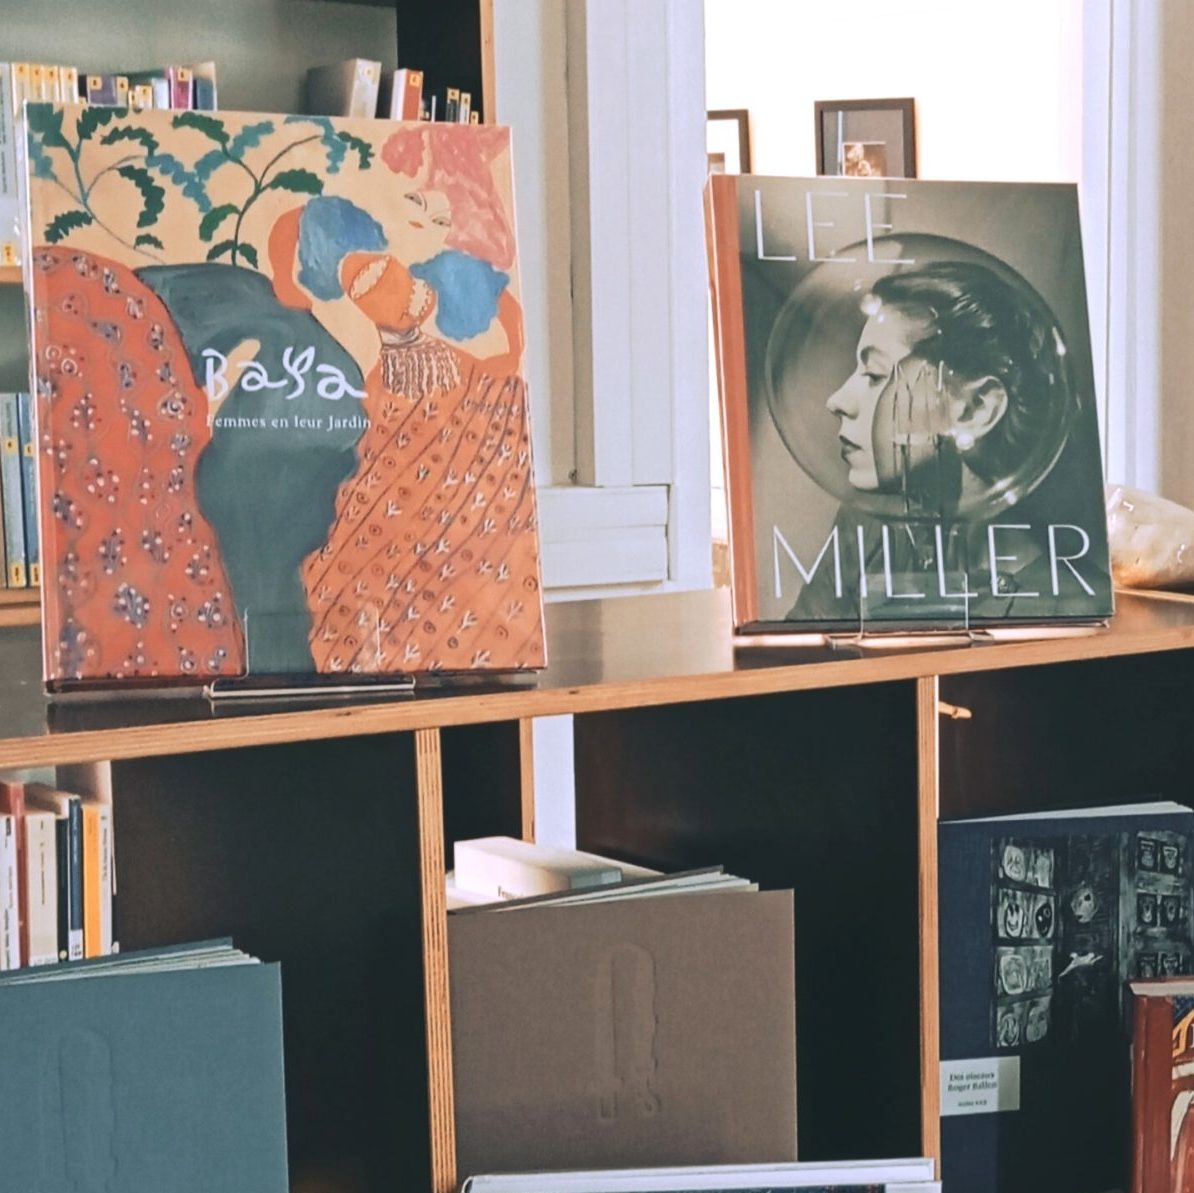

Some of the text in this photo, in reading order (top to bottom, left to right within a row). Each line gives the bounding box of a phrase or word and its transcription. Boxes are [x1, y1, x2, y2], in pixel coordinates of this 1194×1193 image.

[755, 190, 916, 264] LEE
[206, 415, 371, 431] Femmes en leur Jardin
[773, 524, 1096, 599] MILLER
